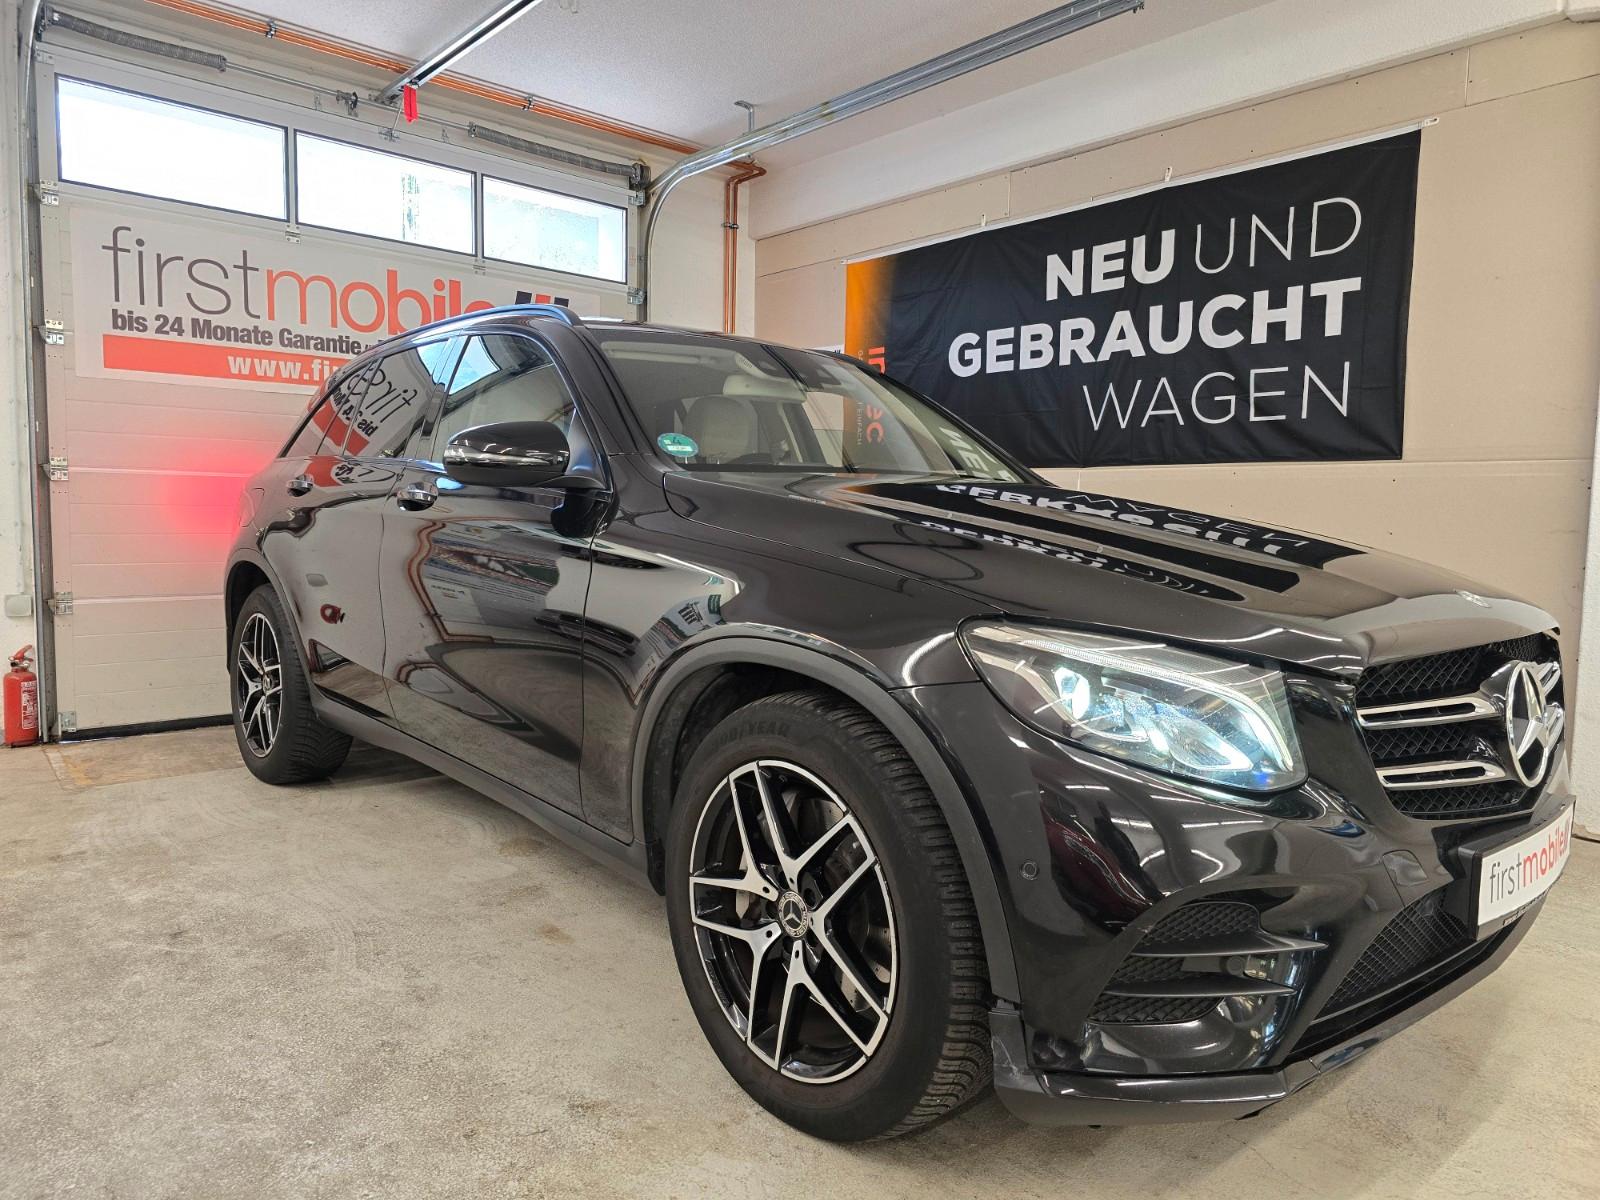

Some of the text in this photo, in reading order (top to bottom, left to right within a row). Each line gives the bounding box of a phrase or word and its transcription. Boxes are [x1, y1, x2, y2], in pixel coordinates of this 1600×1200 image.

[102, 225, 496, 335] firstmobil
[1046, 197, 1362, 301] NEU UND
[111, 308, 362, 355] bis 24 Monate Garantie
[948, 276, 1362, 378] GEBRAUCHT
[1083, 361, 1351, 431] WAGEN
